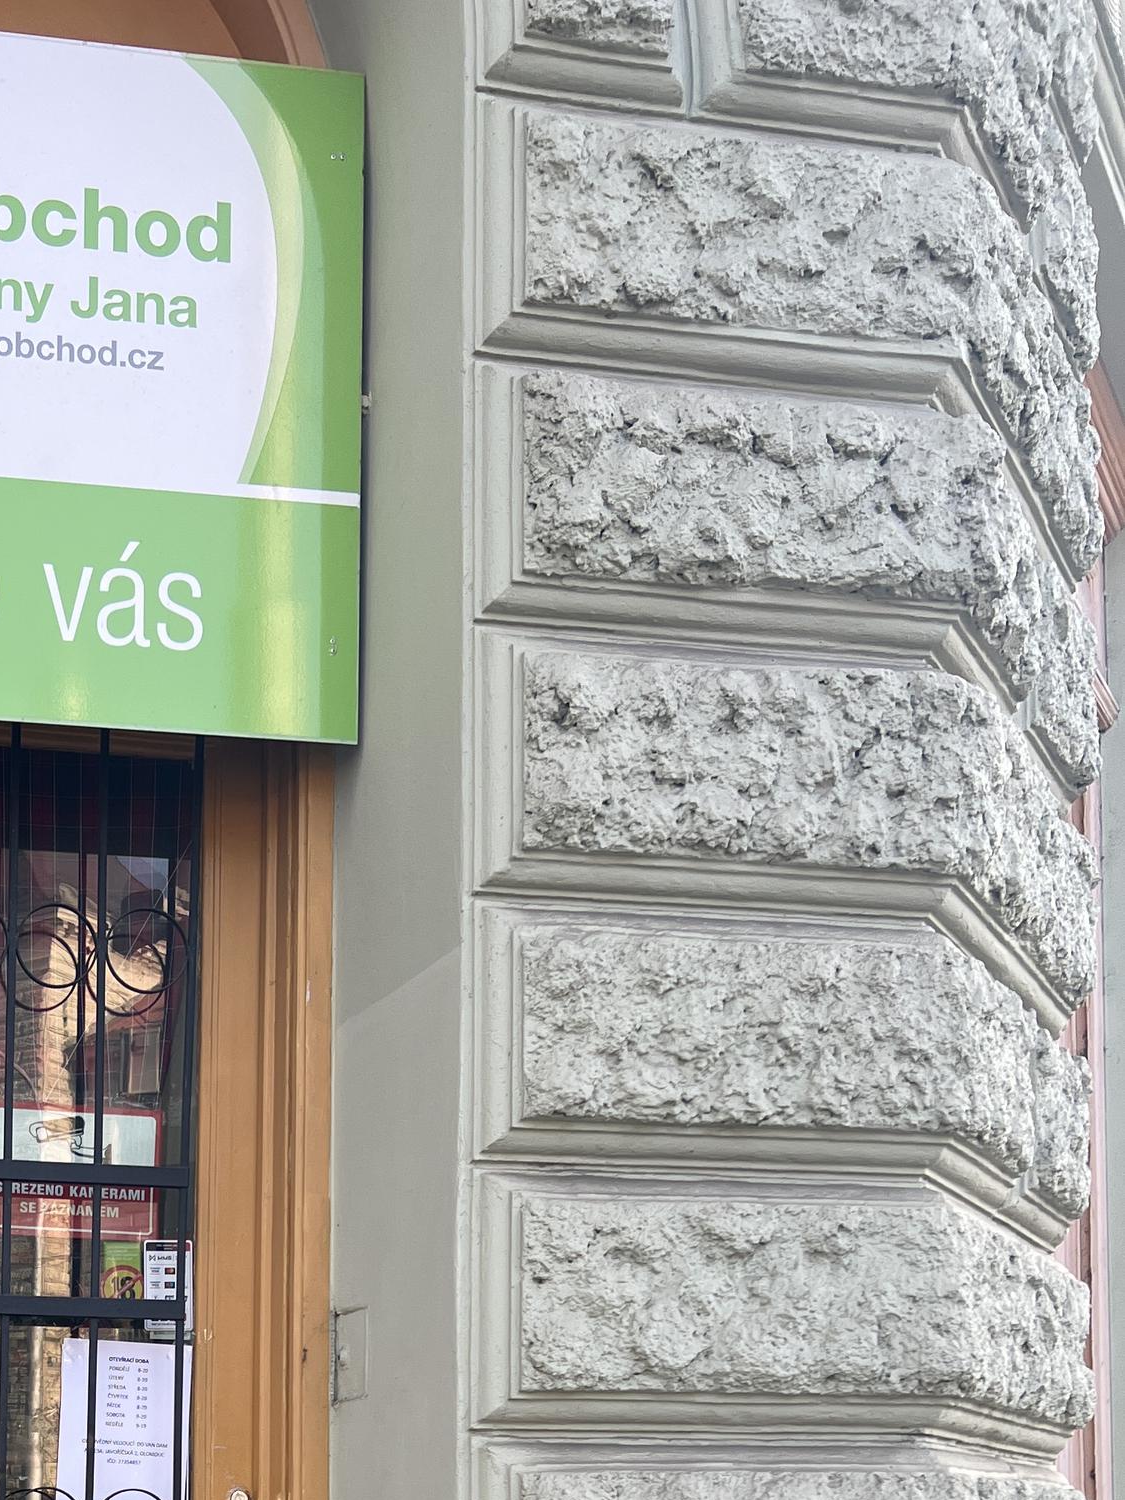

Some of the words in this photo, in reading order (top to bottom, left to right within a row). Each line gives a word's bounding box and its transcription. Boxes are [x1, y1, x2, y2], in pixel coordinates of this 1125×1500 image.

[70, 275, 198, 329] Jana
[43, 541, 205, 652] vás
[20, 1201, 36, 1214] SE
